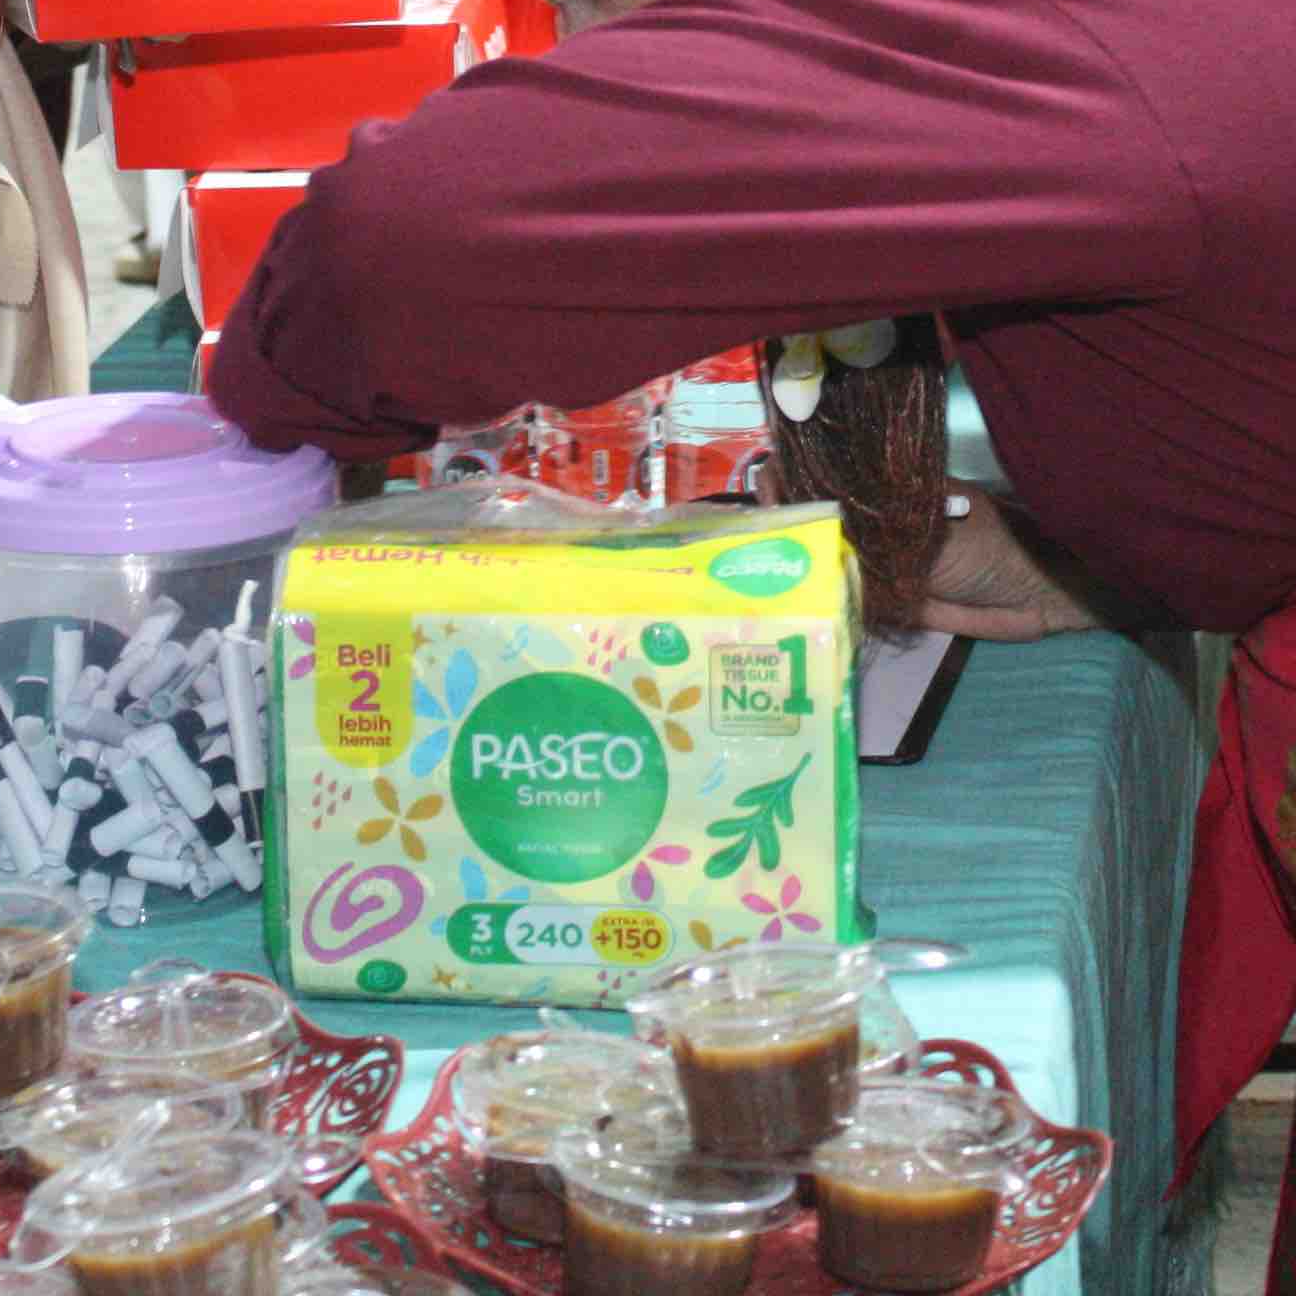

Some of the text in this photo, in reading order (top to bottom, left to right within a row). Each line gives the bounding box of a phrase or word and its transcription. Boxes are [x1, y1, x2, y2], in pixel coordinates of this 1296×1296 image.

[336, 643, 392, 667] Beli
[721, 633, 815, 716] No. 1
[349, 670, 381, 712] 2
[338, 714, 392, 732] lebih
[338, 732, 392, 747] hemat
[470, 731, 644, 781] PASEO
[516, 784, 603, 809] Smart
[470, 913, 494, 944] 3
[516, 922, 584, 949] 240
[595, 927, 663, 951] +150
